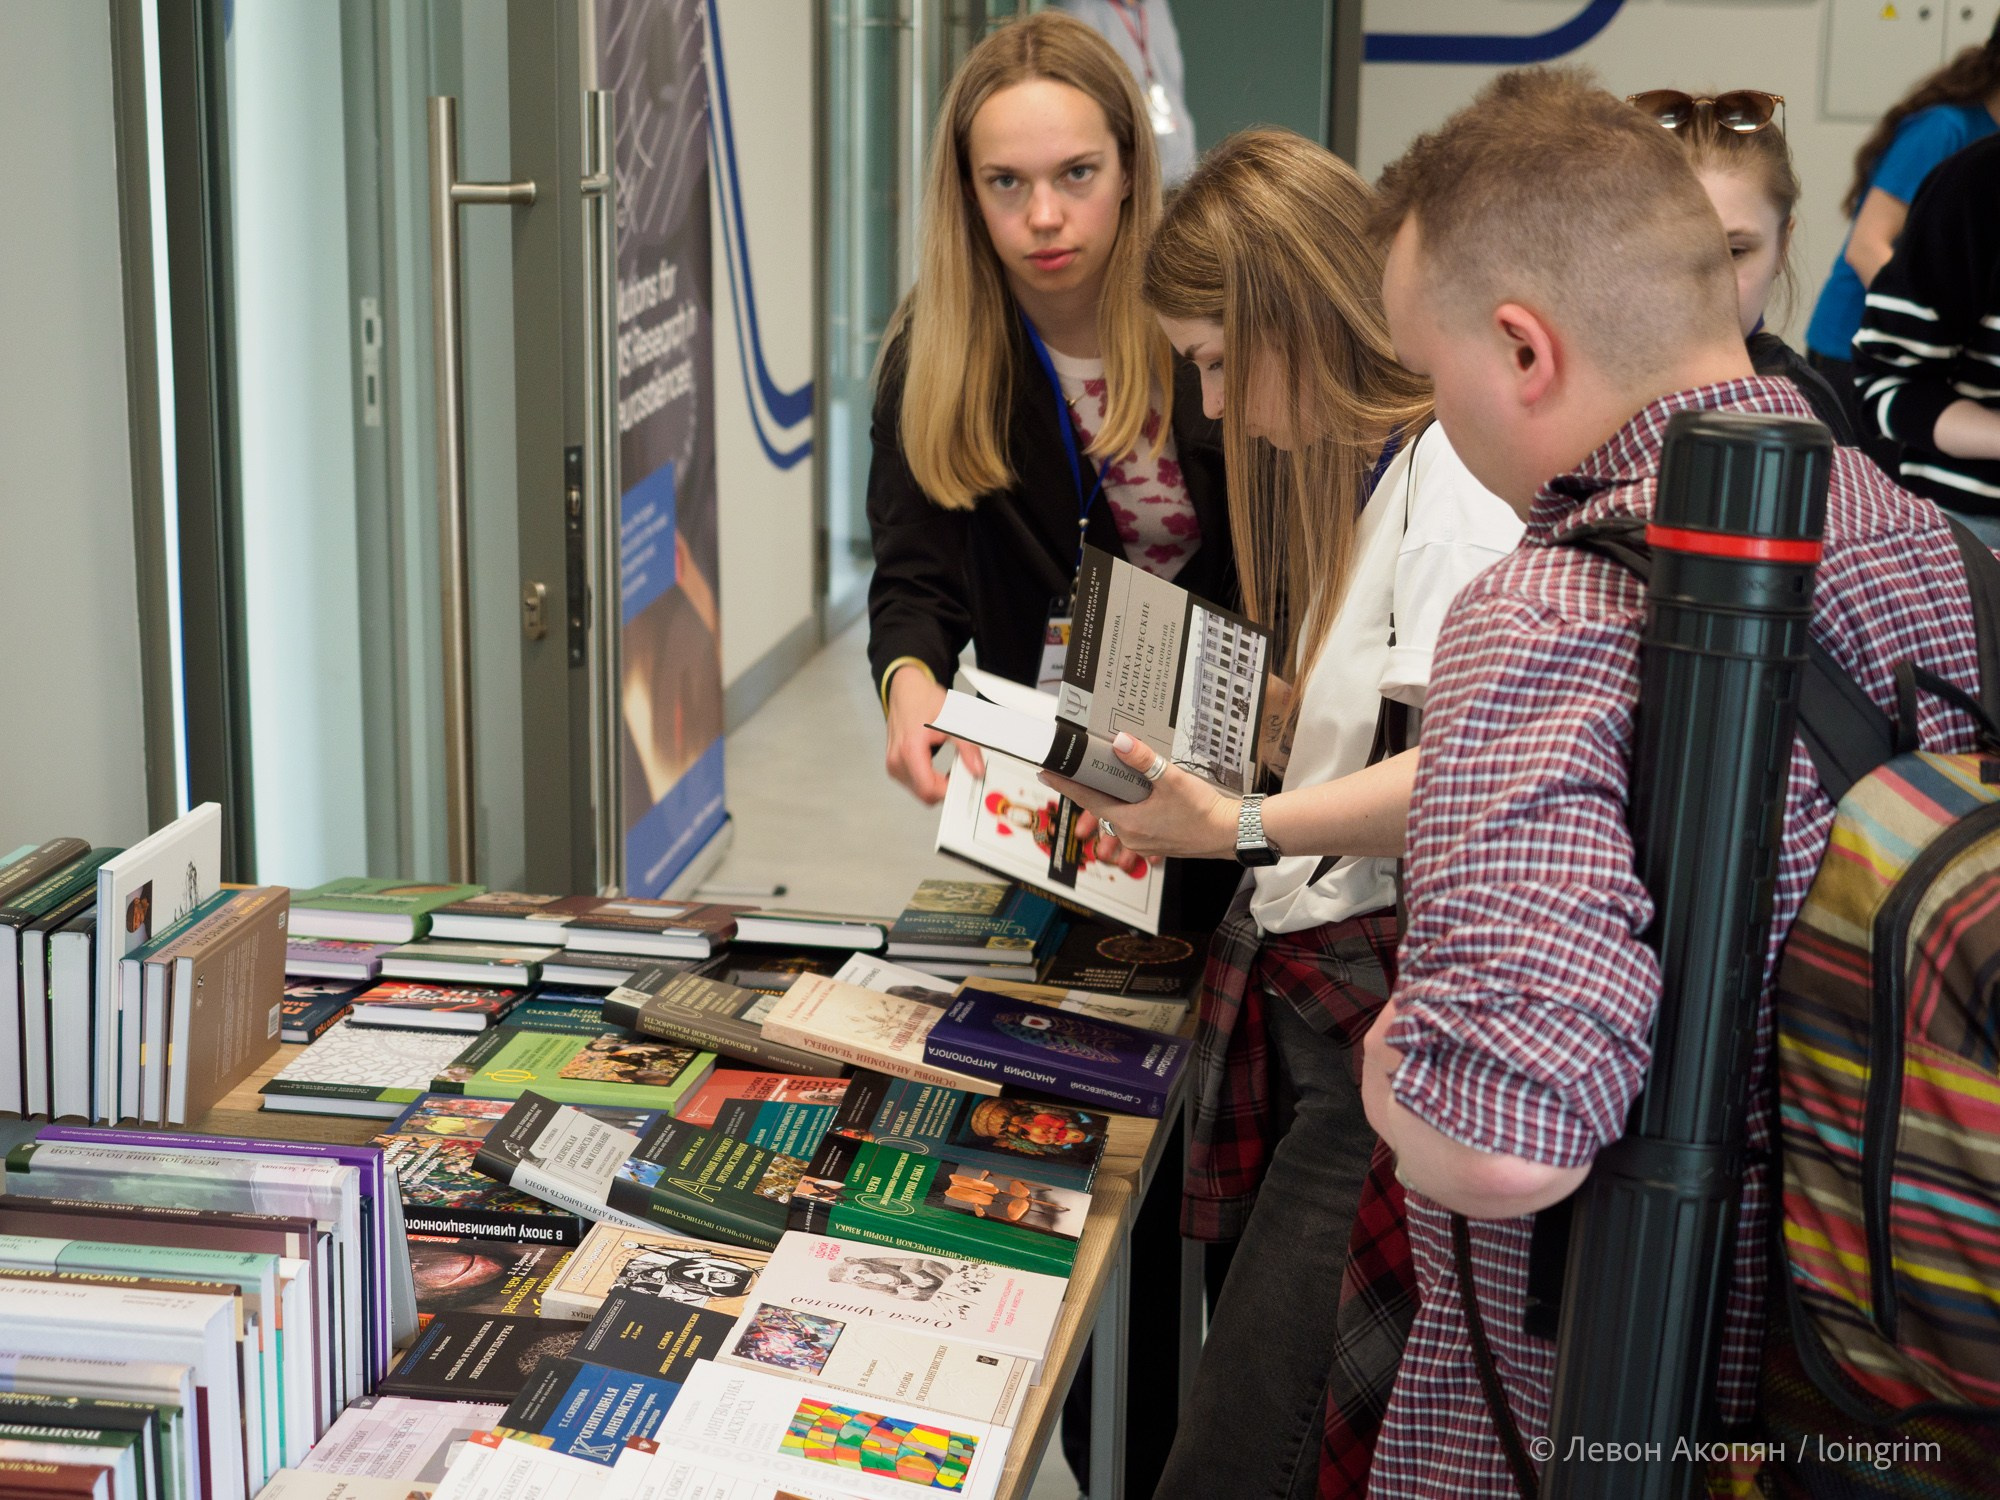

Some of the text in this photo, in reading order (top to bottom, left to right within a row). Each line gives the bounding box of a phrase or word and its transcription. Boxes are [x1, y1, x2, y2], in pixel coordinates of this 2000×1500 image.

[1076, 638, 1086, 677] РАЗУМНОЕ
[1082, 594, 1093, 637] ПОВЕДЕНИЕ
[1081, 640, 1091, 679] LANGUAGE
[1090, 581, 1100, 620] REASONING
[1108, 614, 1122, 667] ЧУПРИКОВА
[1129, 600, 1150, 698] ПСИХИЧЕСКИЕ
[1138, 644, 1155, 716] ПРОЦЕССЫ
[1151, 624, 1169, 709] СИСТЕМА ПОНЯТИЙ
[1159, 621, 1176, 712] ОБЩЕЙ ПСИХОЛОГИИ
[1091, 757, 1136, 784] ПРОЦЕССЫ
[644, 1016, 692, 1035] РЕАЛЬНОСТИ
[693, 1029, 752, 1052] БИОЛОГИЧЕСКОЙ
[803, 1037, 956, 1088] ОСНОВЫ АНАТОМИИ ЧЕЛОВЕКА
[926, 1045, 997, 1071] АНТРОПОЛОГА
[1002, 1062, 1056, 1085] АНАТОМИЯ
[1067, 1077, 1132, 1102] ДРОБЫШЕВСКИЙ
[50, 1147, 104, 1158] РУССКОЙ
[106, 1151, 124, 1159] ПО
[127, 1153, 220, 1167] ИССЛЕДОВАНИЯ
[715, 1142, 749, 1184] ПРОТИВОСТОЯНИЯ
[523, 1177, 609, 1221] ДЕЯТЕЛЬНОСТЬ МОЗГА
[652, 1203, 715, 1229] ПРОТИВОСТОЯНИЯ
[519, 1224, 553, 1240] эпоху
[714, 1223, 752, 1241] НАУЧНОГО
[835, 1222, 894, 1244] ТЕОРИИ ЯЗЫКА
[150, 1249, 237, 1260] ИСТОРИЧЕСКАЯ
[59, 1273, 140, 1284] ЯЗЫКОВАЯ
[501, 1277, 540, 1315] рассказали
[790, 1296, 953, 1330] Ольга Арнольд
[444, 1357, 467, 1381] СЛОВАРЬ
[464, 1319, 495, 1354] ГРАММАТИКА
[469, 1324, 516, 1379] ЛИНГВОКУЛЬТУРЫ
[895, 1371, 914, 1398] ОСНОВЫ
[915, 1344, 949, 1402] ПСИХОЛИНГВИСТИКИ
[602, 1382, 646, 1438] ЛИНГВИСТИКА
